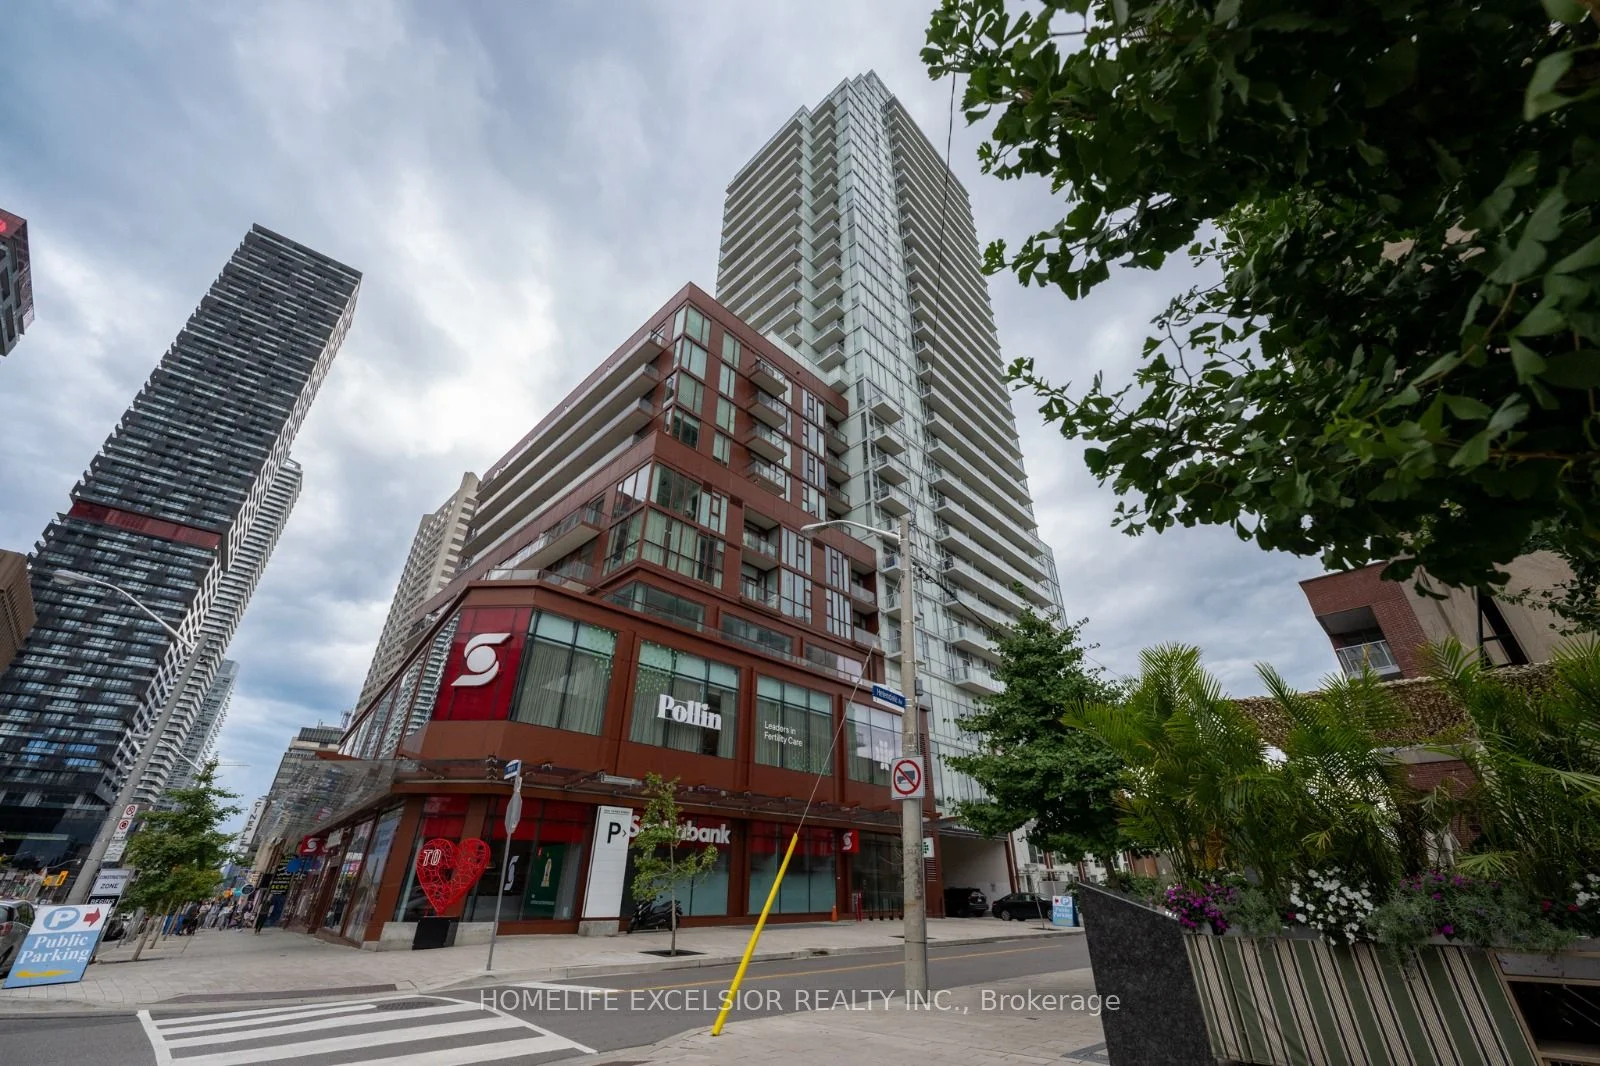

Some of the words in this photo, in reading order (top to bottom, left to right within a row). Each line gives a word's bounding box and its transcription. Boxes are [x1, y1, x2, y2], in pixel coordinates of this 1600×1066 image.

[657, 694, 722, 730] Pollin
[764, 720, 790, 734] Leaders
[790, 727, 797, 735] in
[764, 731, 787, 745] Fertility
[788, 736, 803, 747] Care
[607, 822, 622, 844] P
[33, 934, 88, 949] Public
[19, 947, 89, 964] Parking
